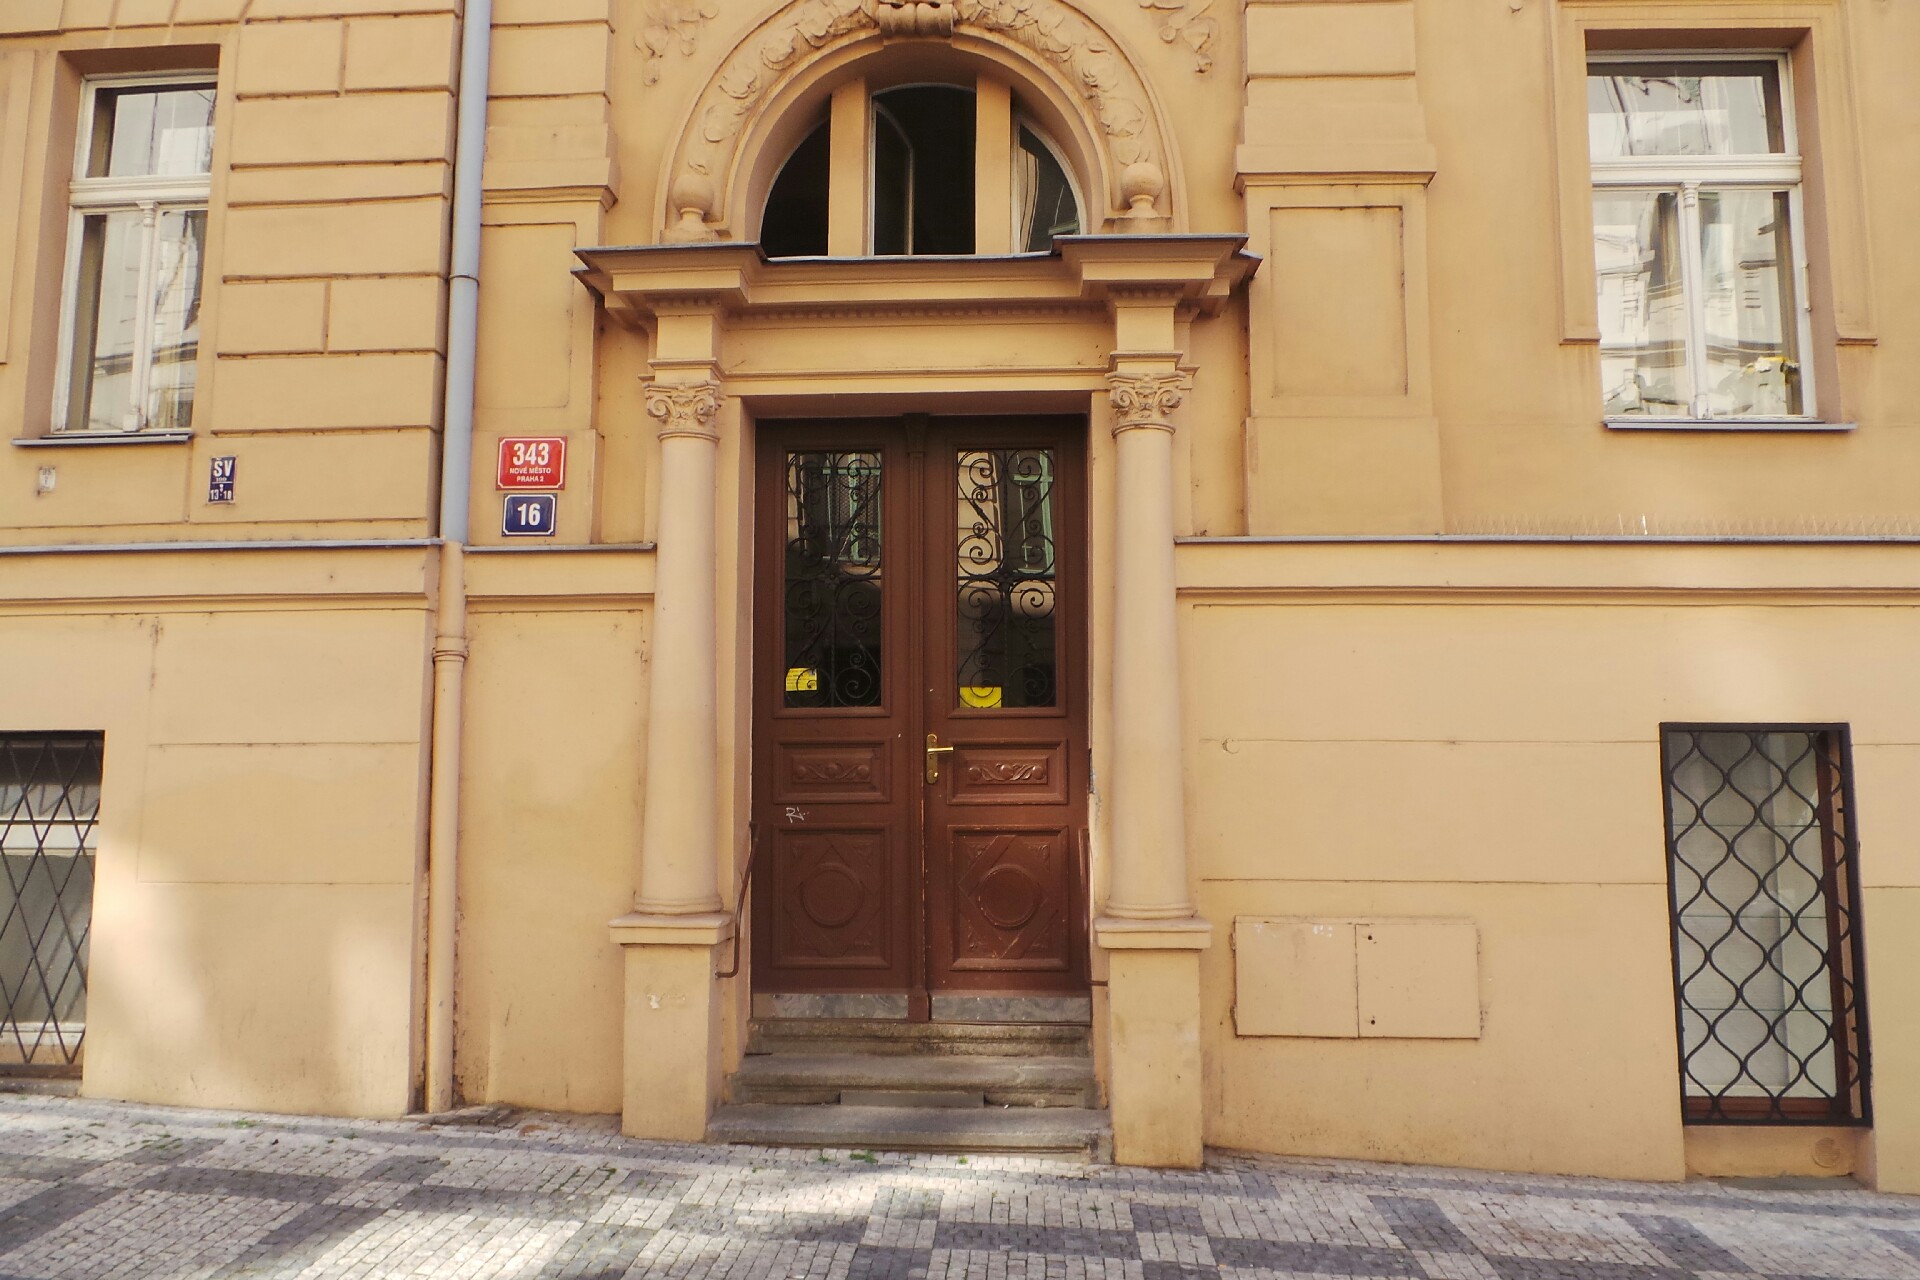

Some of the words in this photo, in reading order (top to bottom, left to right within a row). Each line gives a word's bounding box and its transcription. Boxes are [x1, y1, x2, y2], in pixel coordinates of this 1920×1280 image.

[512, 442, 549, 466] 343
[509, 466, 528, 474] NOVÉ
[517, 503, 541, 526] 16
